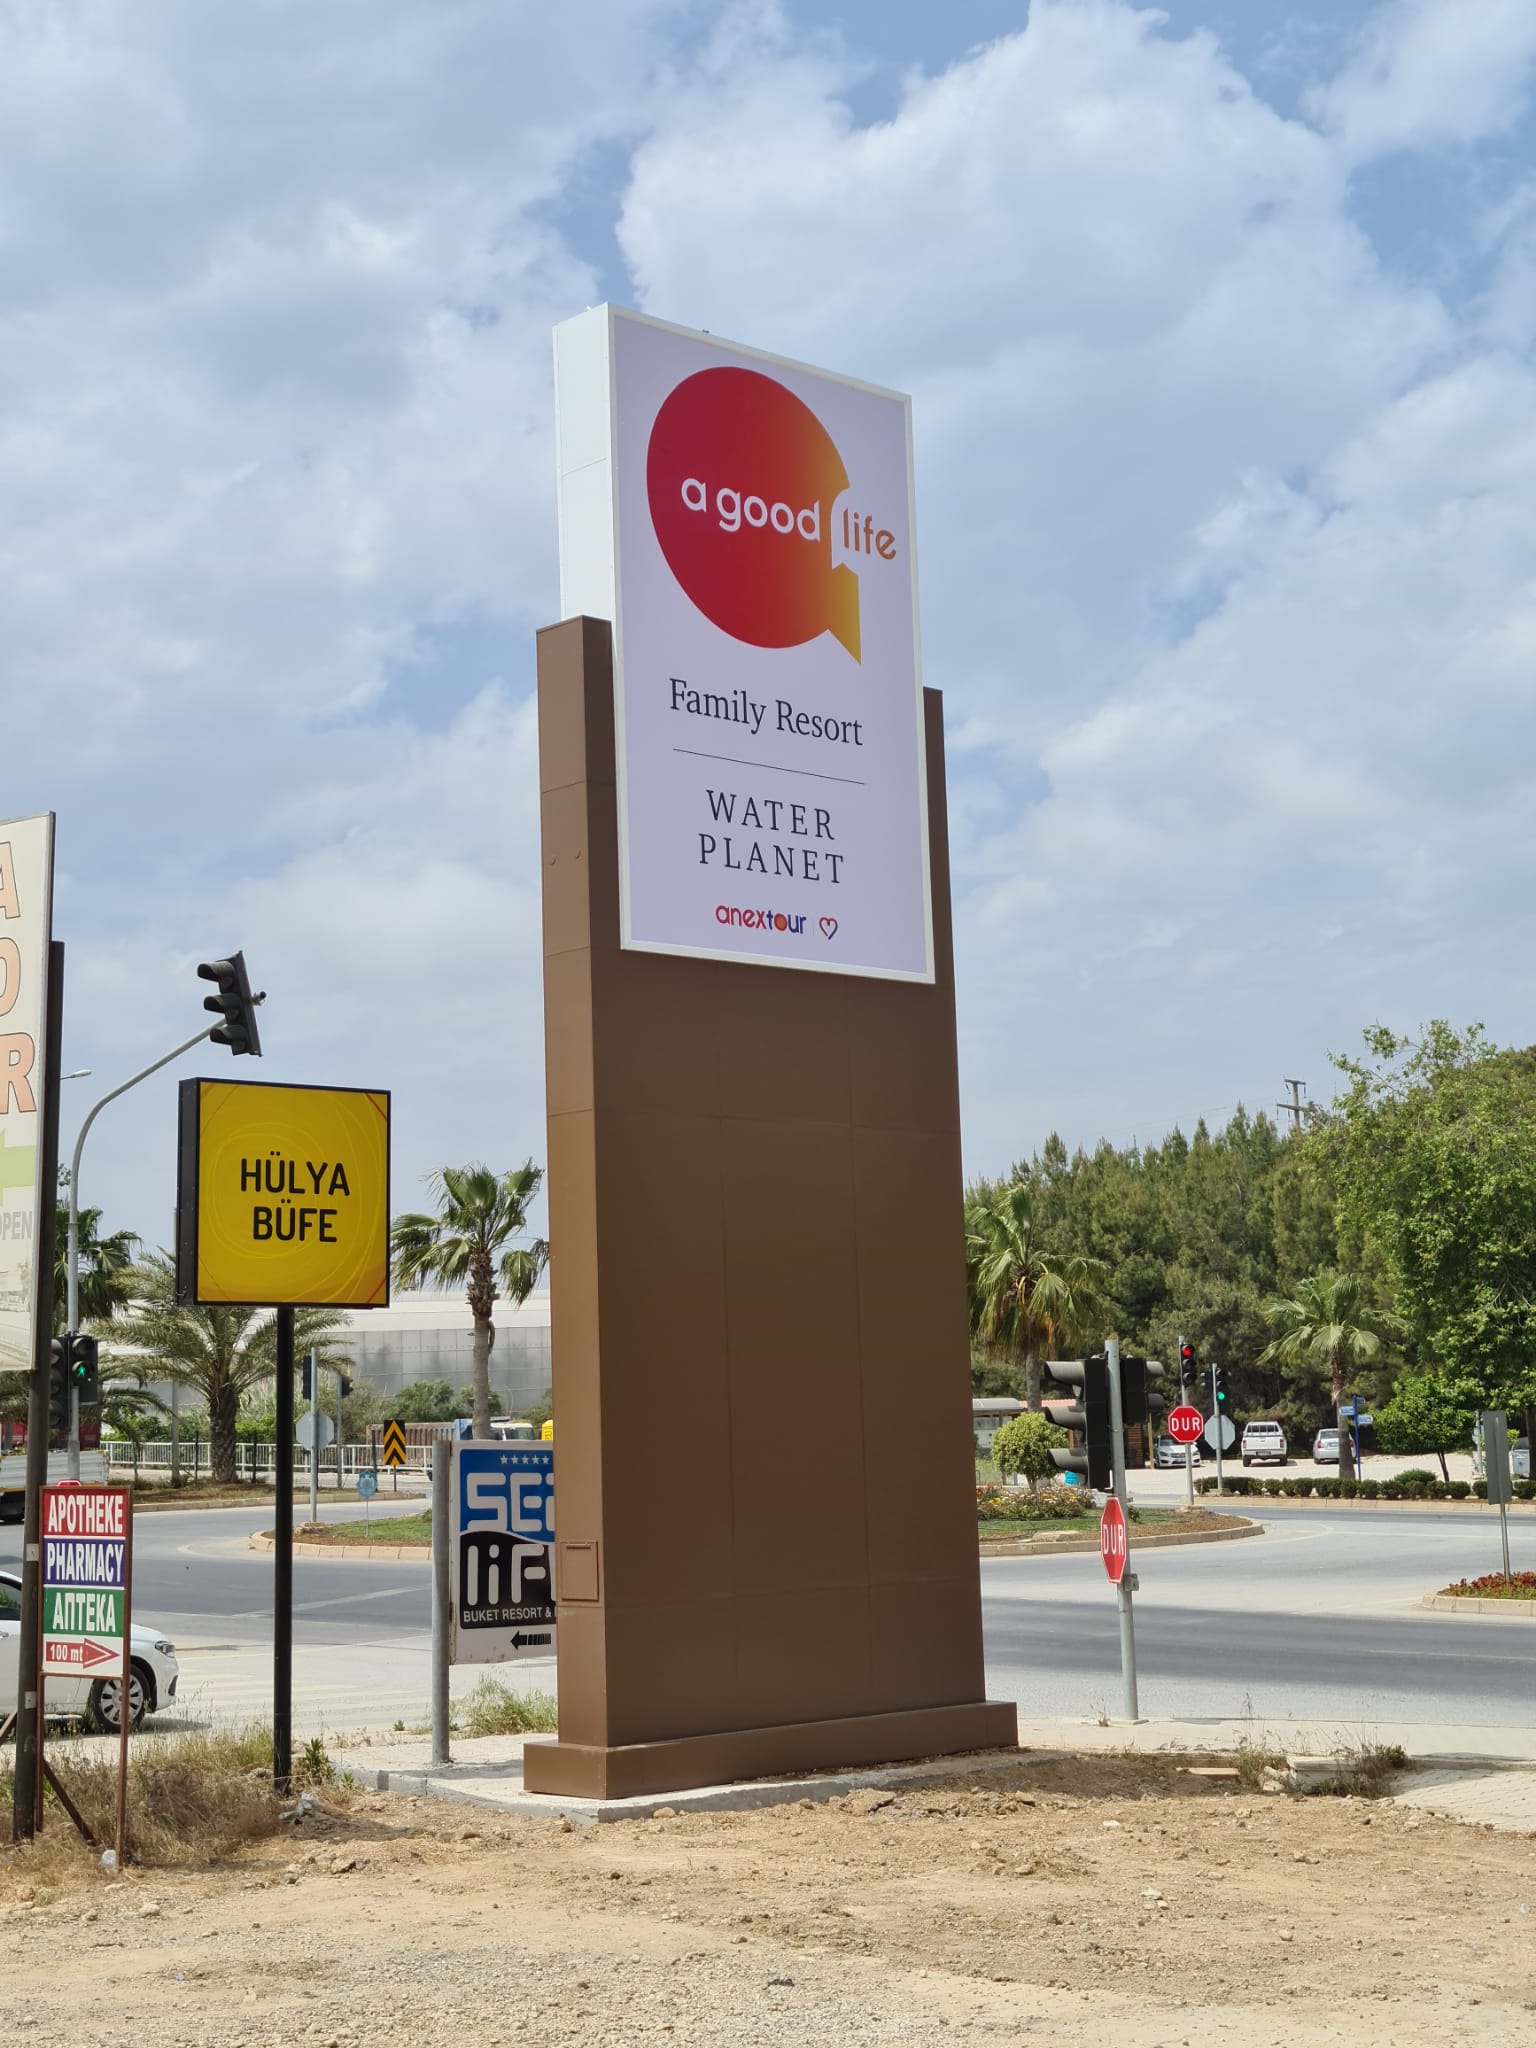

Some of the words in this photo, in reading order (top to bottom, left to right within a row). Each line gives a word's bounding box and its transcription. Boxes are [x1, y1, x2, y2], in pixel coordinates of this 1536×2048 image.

[681, 477, 707, 513] a
[716, 488, 820, 543] good
[842, 507, 897, 560] life
[669, 677, 767, 735] Family
[775, 699, 864, 747] Resort
[706, 789, 835, 841] WATER
[698, 832, 844, 884] PLANET
[715, 904, 807, 935] anextour
[241, 1150, 350, 1196] HÜLYA
[0, 1210, 33, 1241] PEN
[253, 1198, 338, 1243] BÜFE
[1171, 1416, 1201, 1433] DUR
[47, 1494, 124, 1534] APOTHEKE
[1103, 1523, 1124, 1555] DUR
[46, 1542, 124, 1583] PHARMACY
[52, 1591, 116, 1633] АПТЕКА
[463, 1608, 499, 1623] BUKET
[502, 1606, 542, 1620] RESORT
[545, 1606, 552, 1618] &
[50, 1643, 68, 1662] 100
